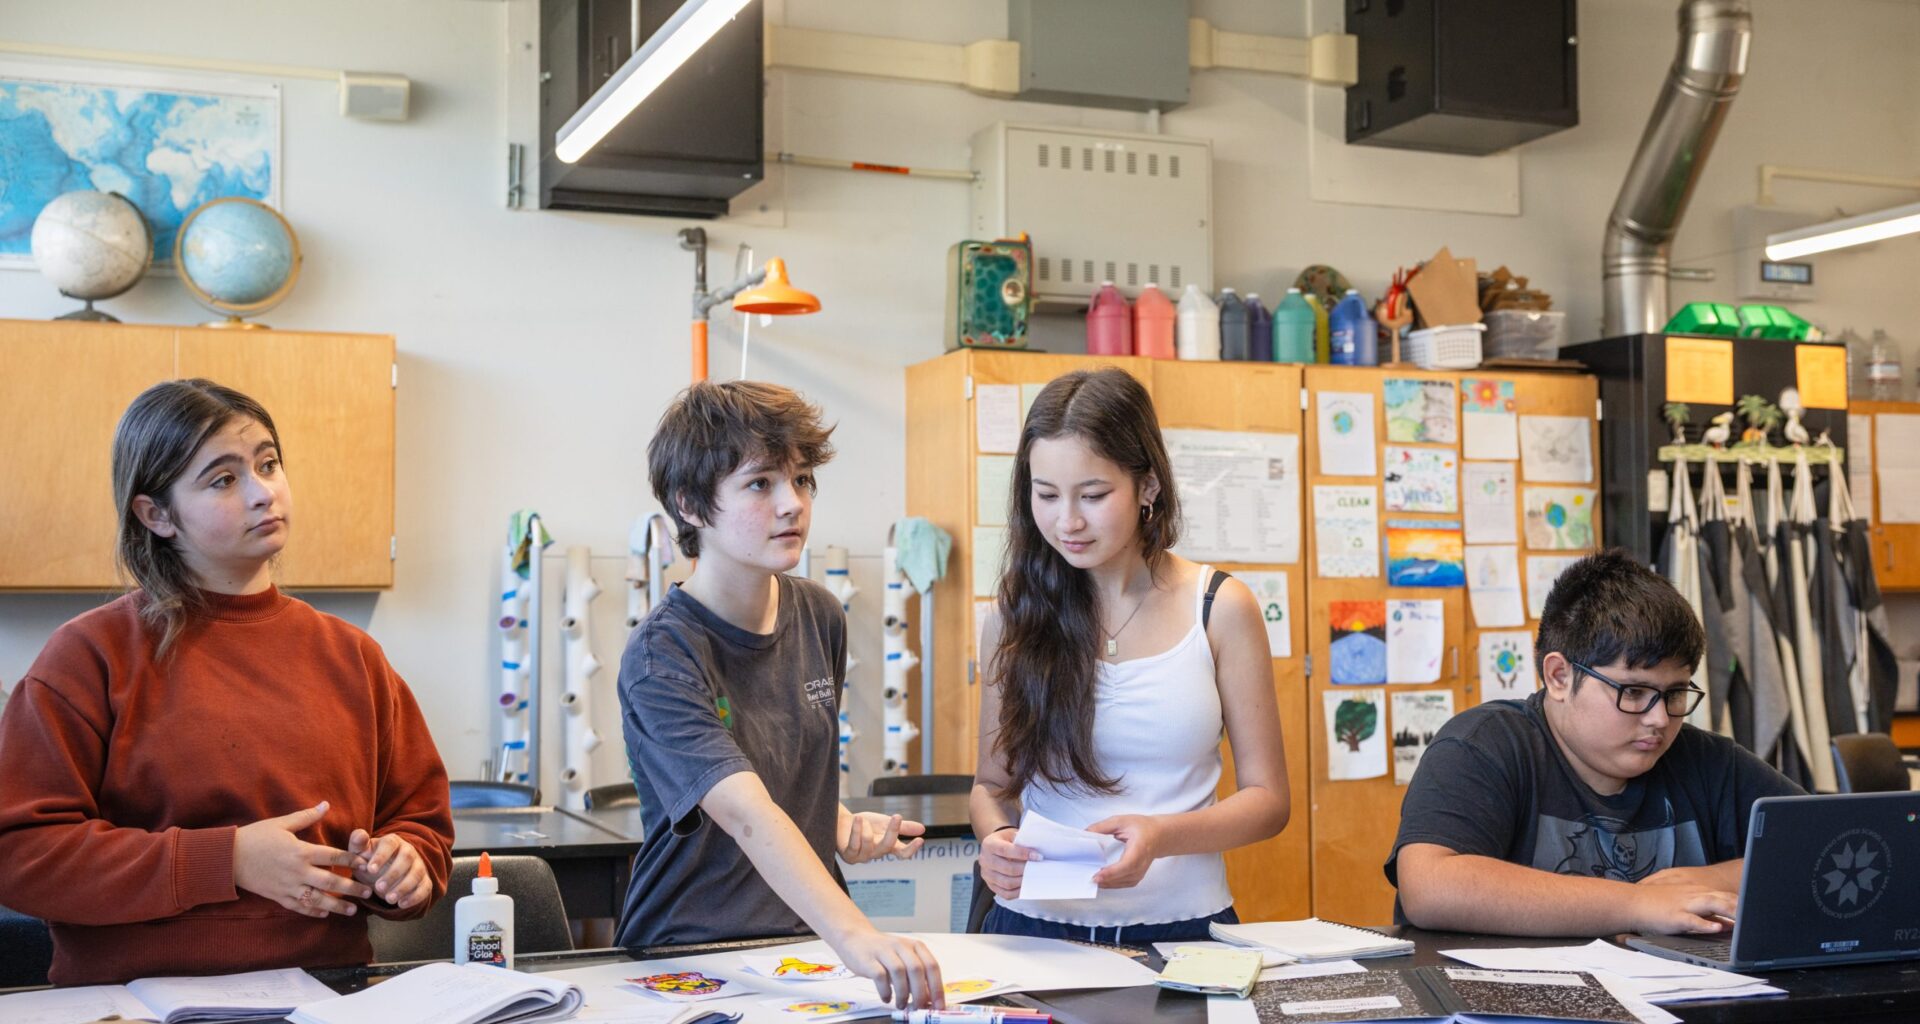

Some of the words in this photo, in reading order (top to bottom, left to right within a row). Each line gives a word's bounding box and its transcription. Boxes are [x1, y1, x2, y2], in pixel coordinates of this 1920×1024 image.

[1894, 929, 1920, 941] RY2
[471, 941, 500, 951] School
[474, 950, 494, 959] Glue
